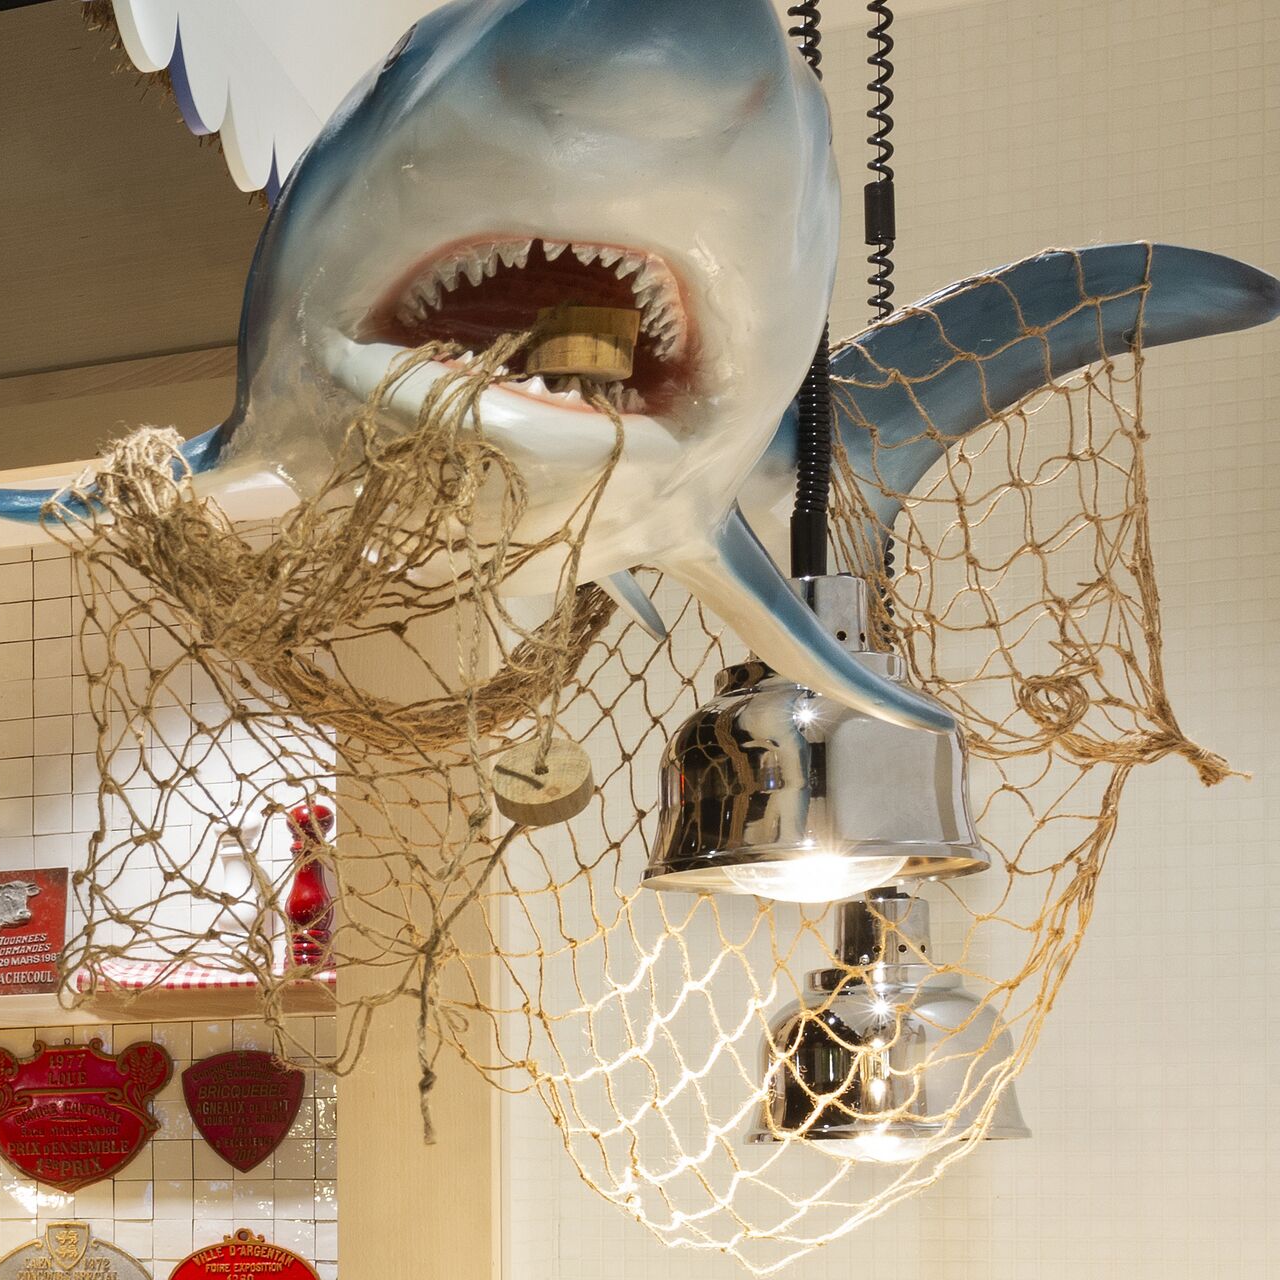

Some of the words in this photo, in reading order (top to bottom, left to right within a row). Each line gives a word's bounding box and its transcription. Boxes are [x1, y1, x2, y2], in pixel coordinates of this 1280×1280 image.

[11, 954, 41, 966] MARS
[49, 1053, 86, 1069] 1977
[198, 1083, 288, 1099] BRICQUEBEC
[195, 1100, 245, 1115] AGNEAUX
[7, 1141, 40, 1156] PRIX
[59, 1157, 104, 1176] PRIX
[192, 1246, 224, 1266] VILLE
[205, 1263, 231, 1273] FOIRE
[233, 1262, 283, 1273] EXPOSITION
